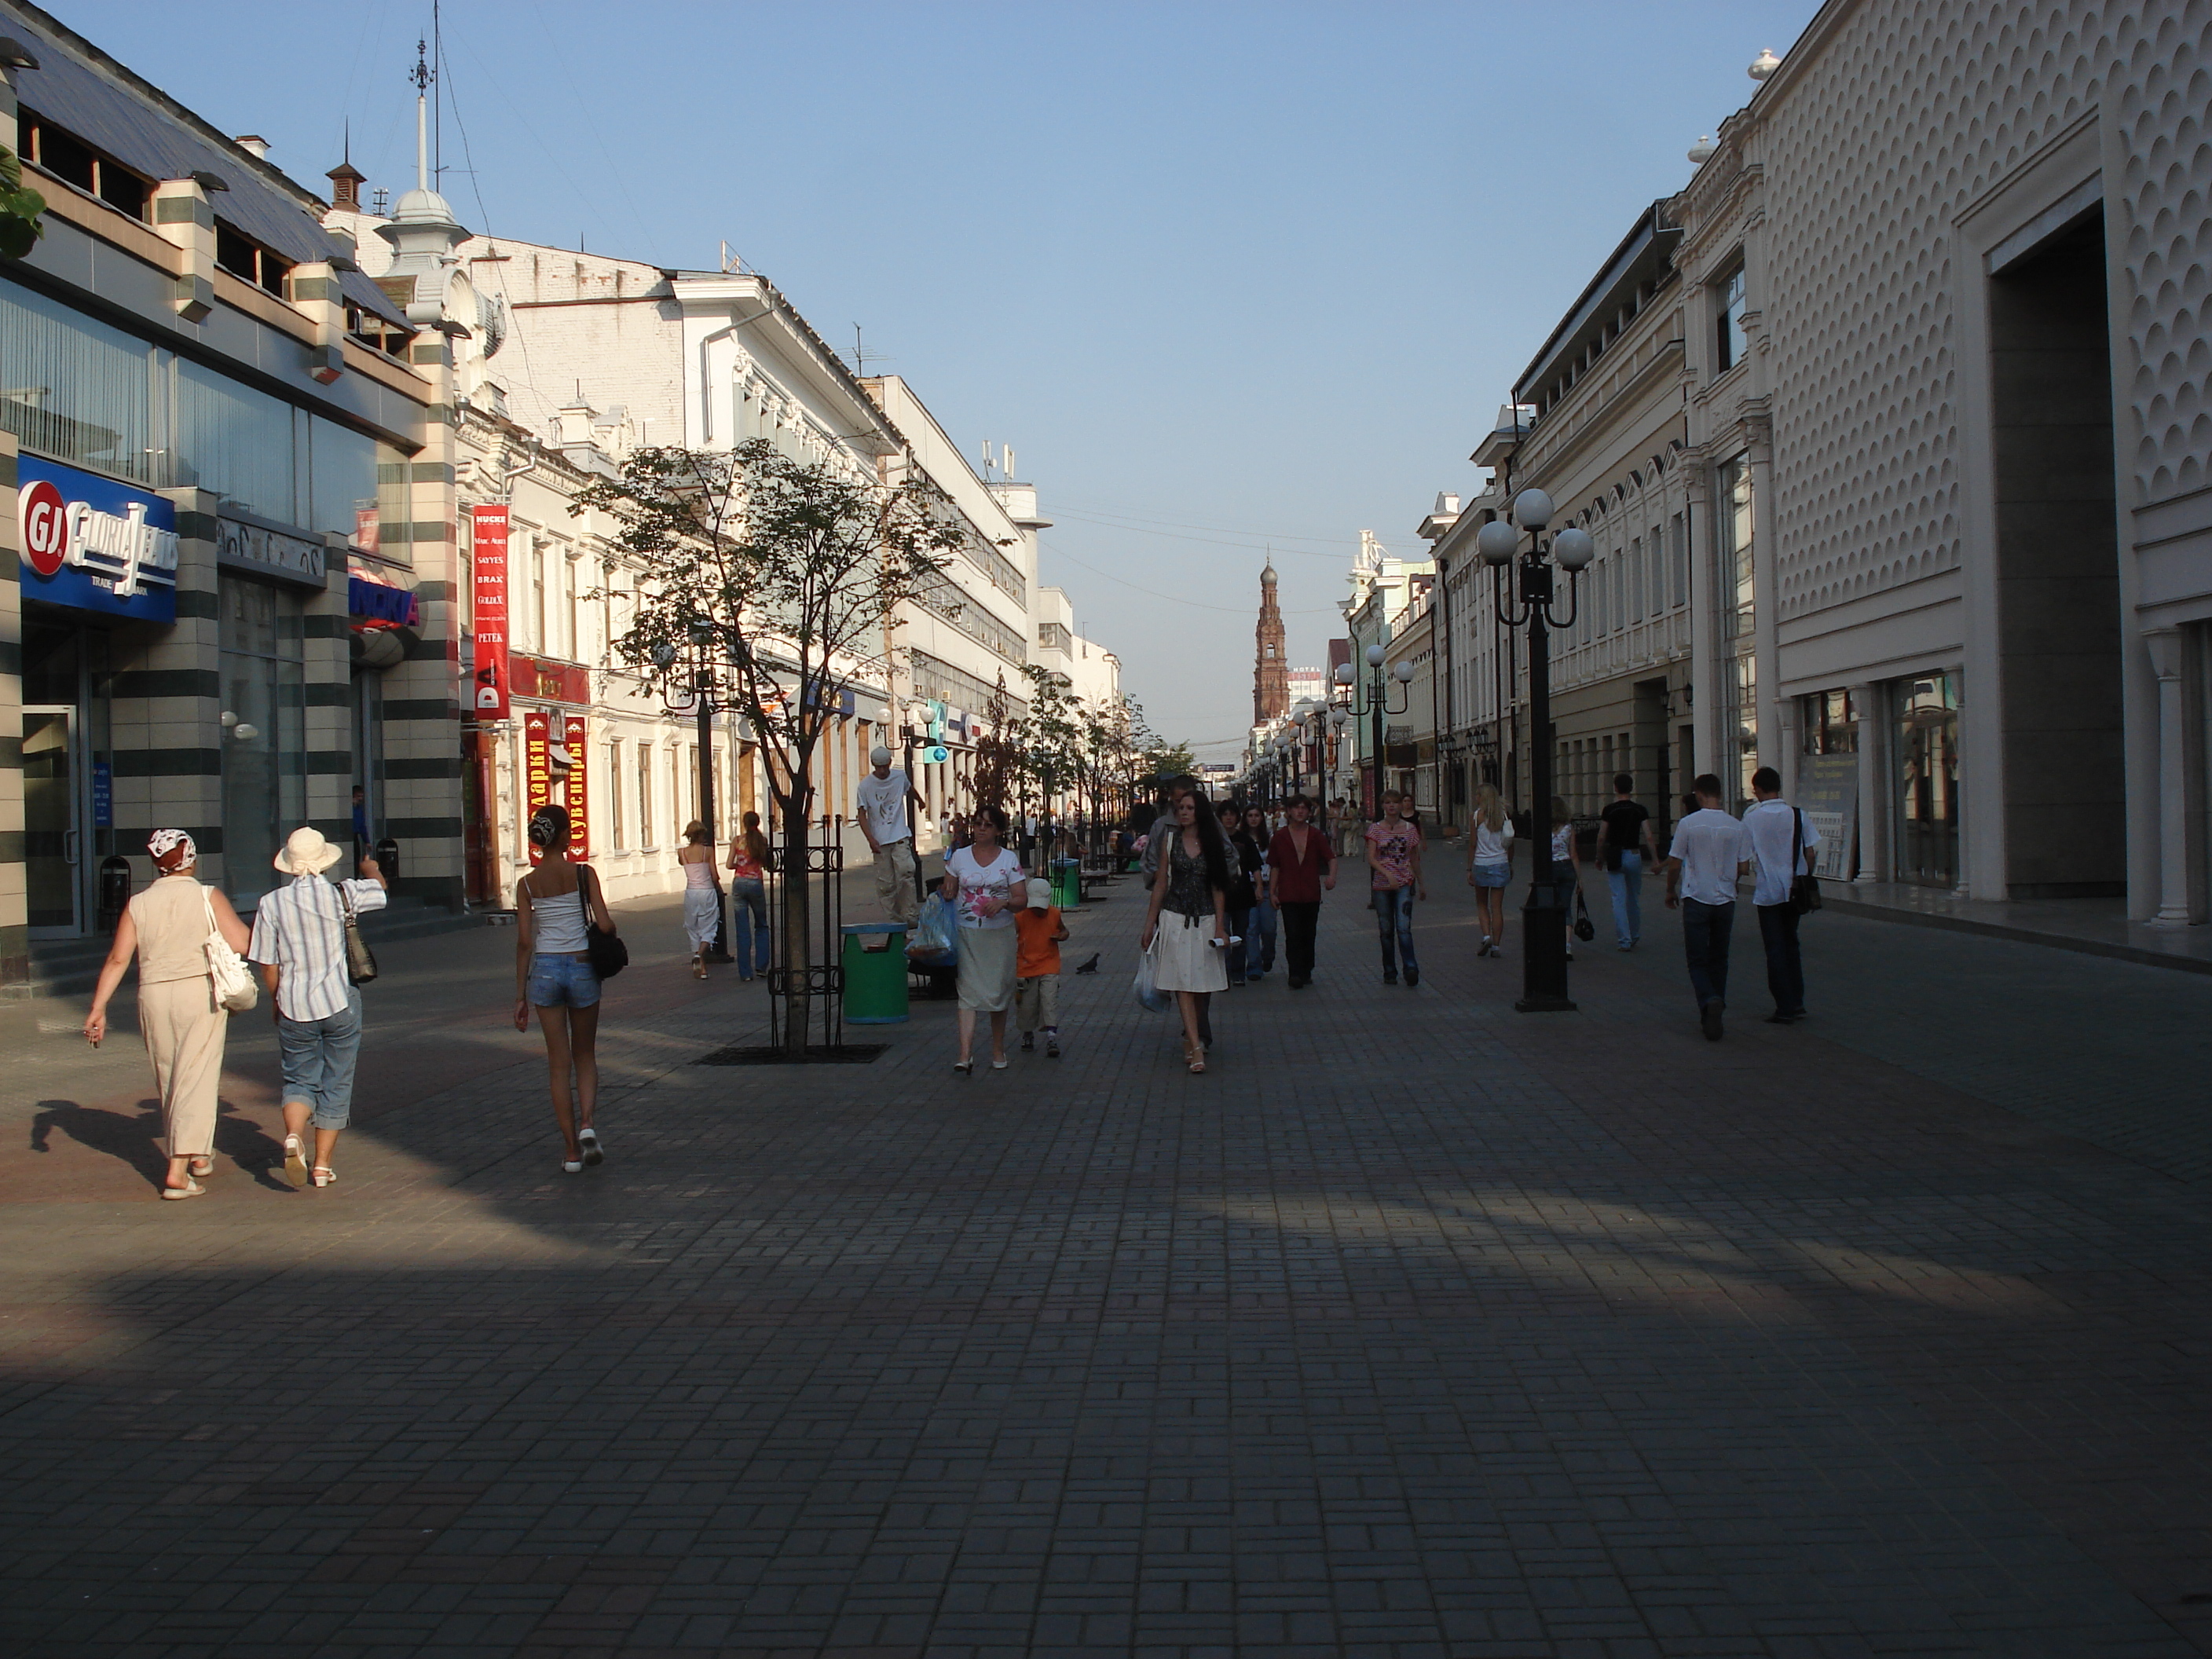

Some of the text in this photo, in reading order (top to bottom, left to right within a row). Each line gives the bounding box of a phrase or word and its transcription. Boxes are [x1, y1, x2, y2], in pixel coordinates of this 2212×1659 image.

[28, 501, 63, 555] GJ
[91, 575, 113, 590] TRADE
[477, 575, 504, 584] BRAX
[350, 577, 419, 627] NOKIA
[478, 632, 503, 643] PETEK
[529, 740, 548, 819] дарки
